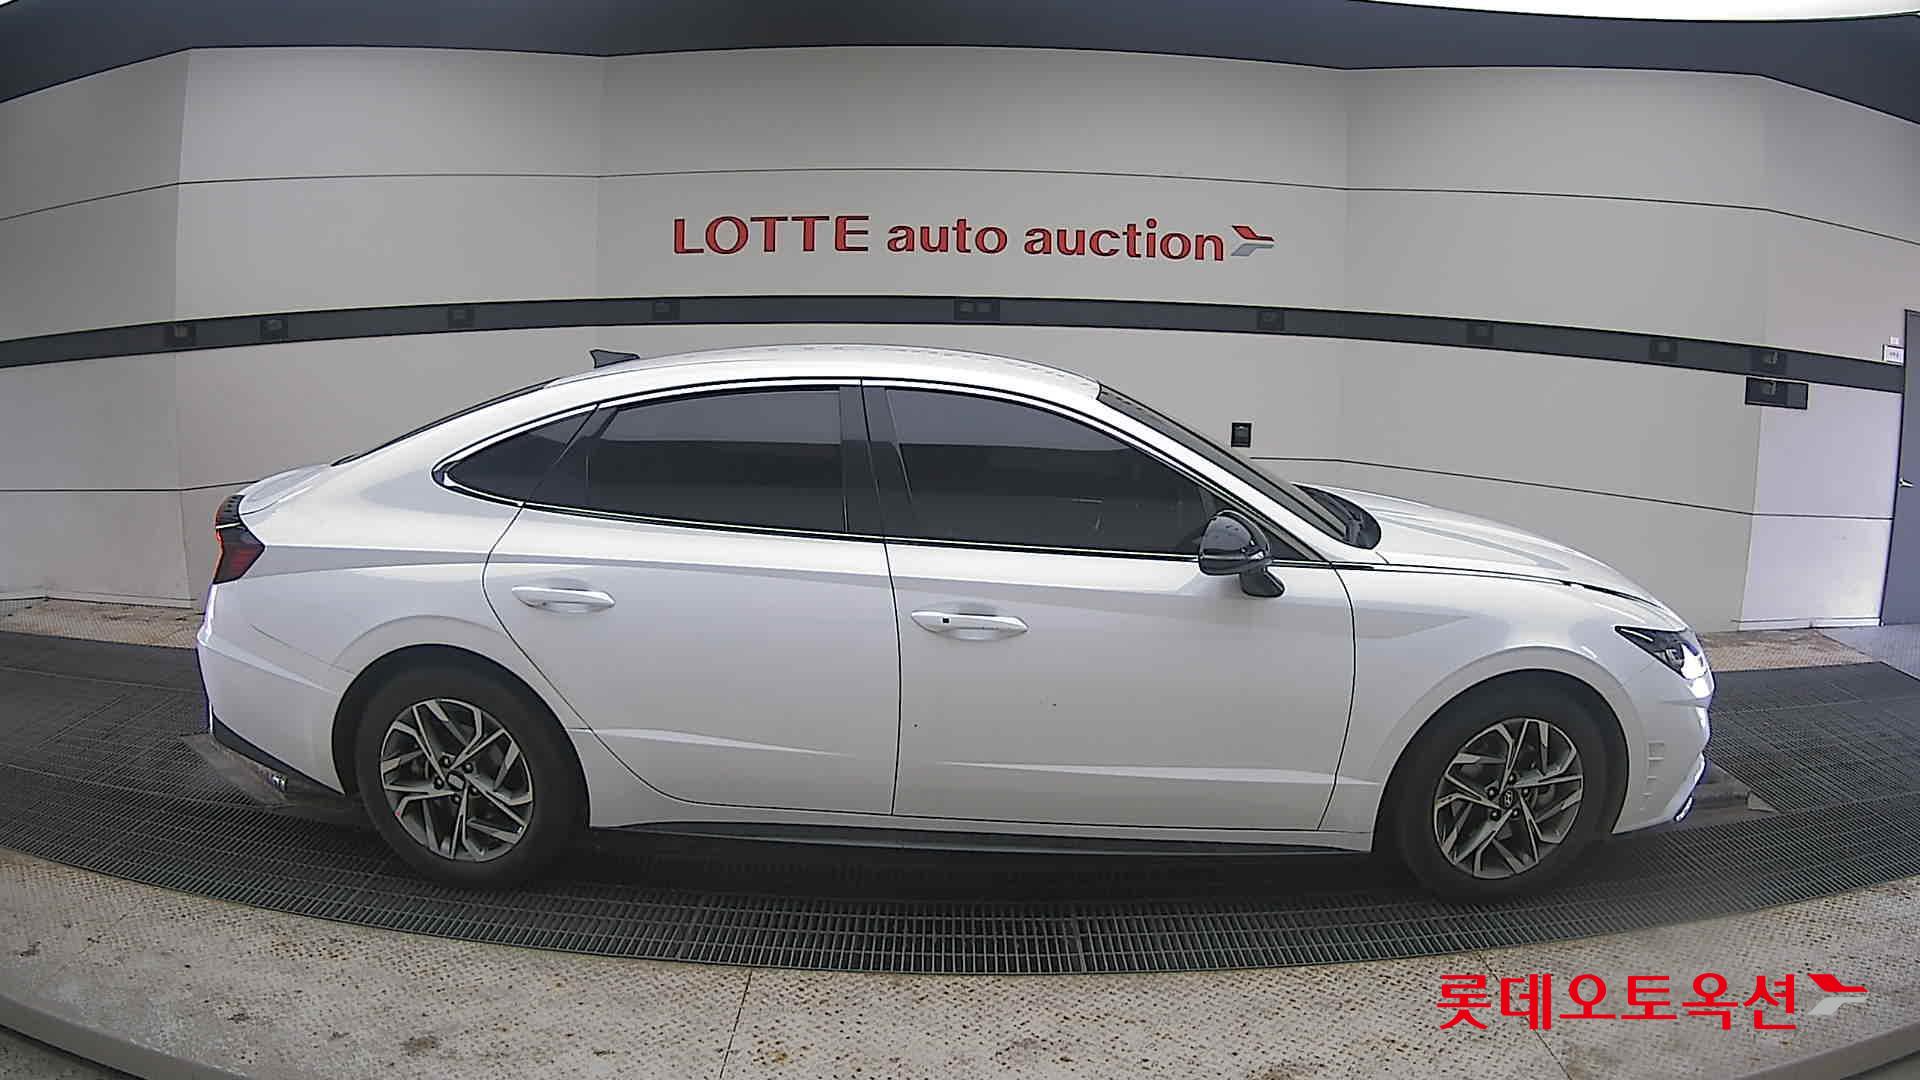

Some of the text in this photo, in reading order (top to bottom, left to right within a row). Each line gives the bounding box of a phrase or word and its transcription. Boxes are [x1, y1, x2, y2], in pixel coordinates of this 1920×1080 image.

[673, 215, 1224, 261] LOTTE auto auction
